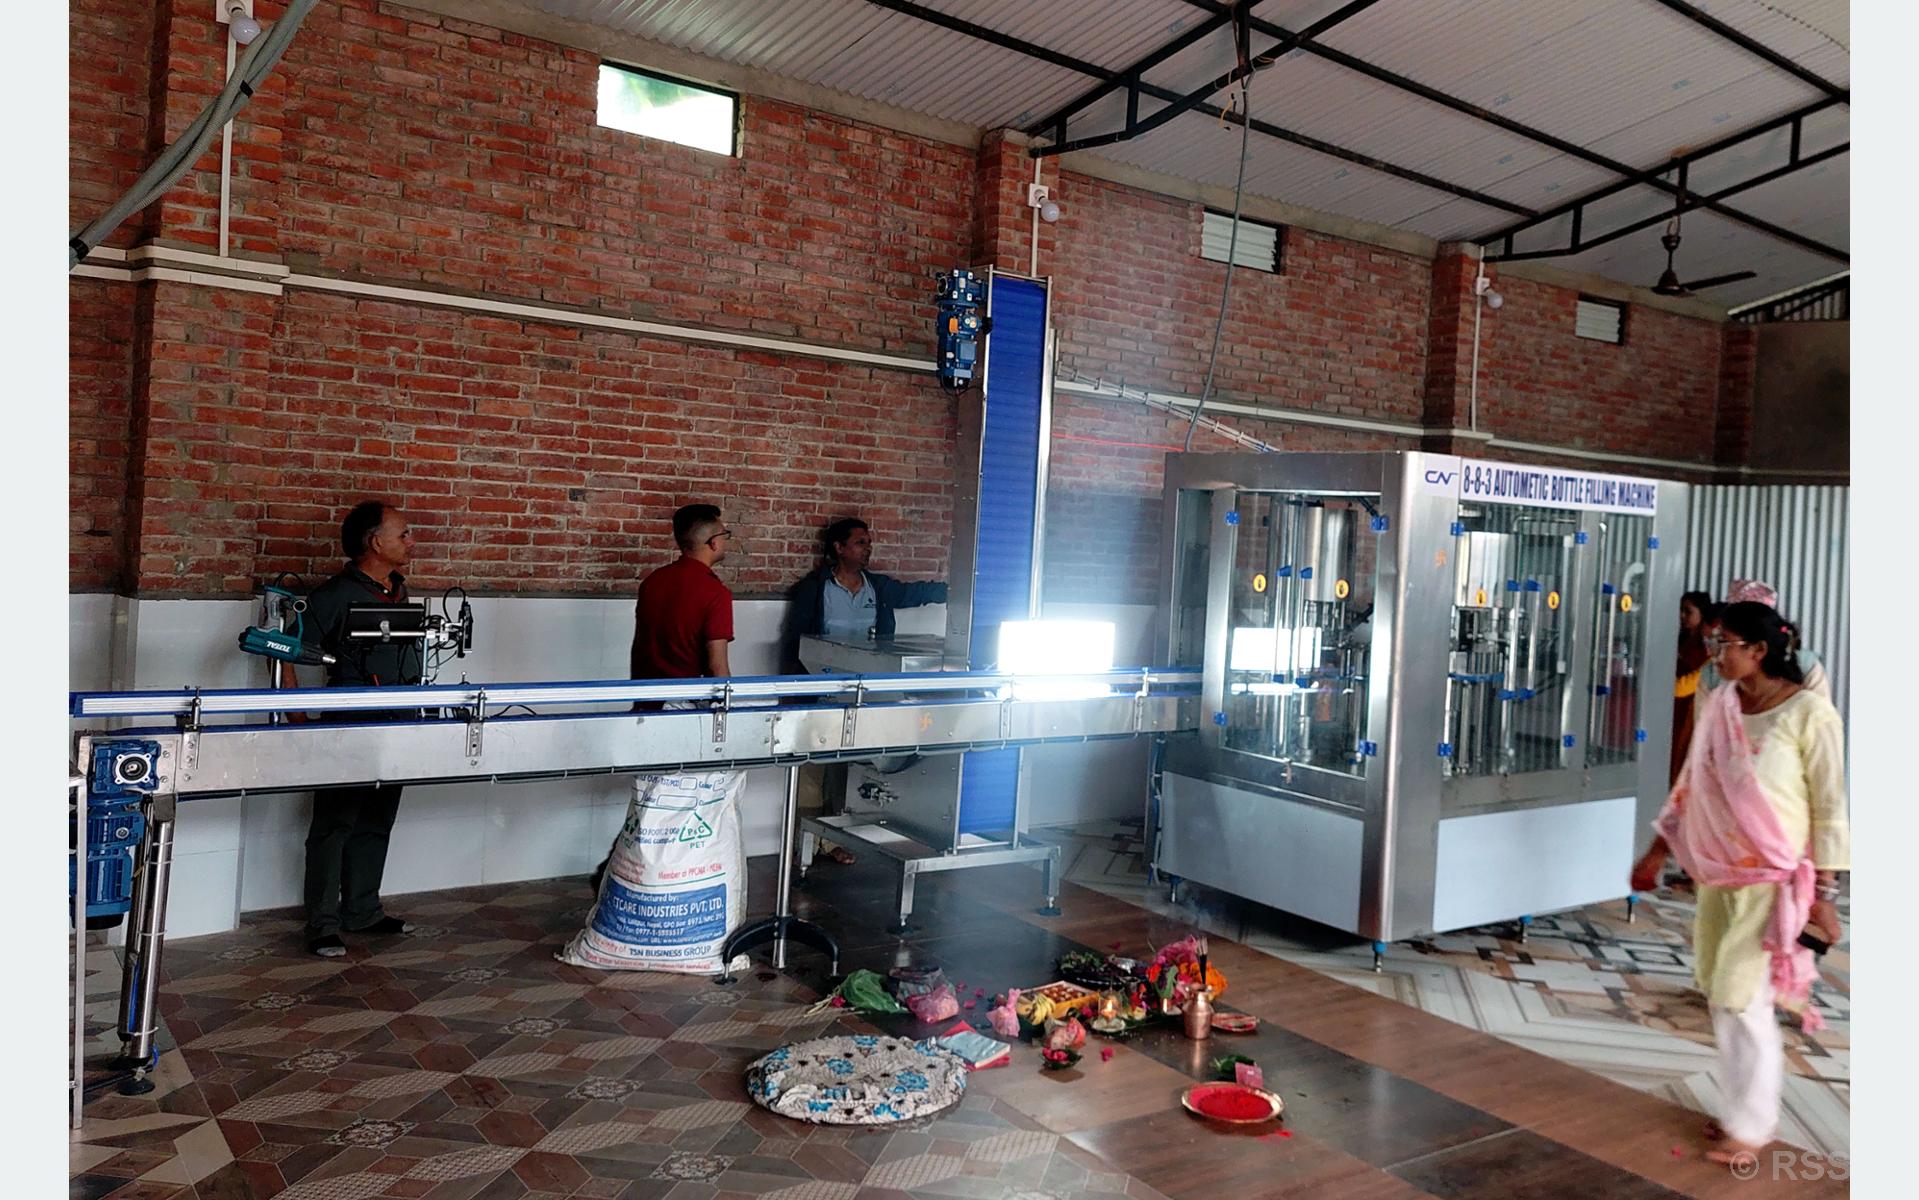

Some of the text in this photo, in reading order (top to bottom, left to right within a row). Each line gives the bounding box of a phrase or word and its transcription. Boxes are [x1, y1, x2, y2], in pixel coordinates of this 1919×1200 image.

[1463, 465, 1656, 509] 8-8-3 AUTOMETIC BOTTLE FILLING MACHINE
[266, 640, 291, 653] TOTAL
[690, 841, 705, 849] PET
[658, 870, 681, 880] Member
[626, 890, 667, 903] Manufactured
[638, 903, 689, 918] INDUSTRIES
[690, 900, 708, 914] PVT.
[709, 897, 724, 911] LTD.
[645, 949, 683, 957] BUSINESS
[684, 945, 712, 956] GROUP
